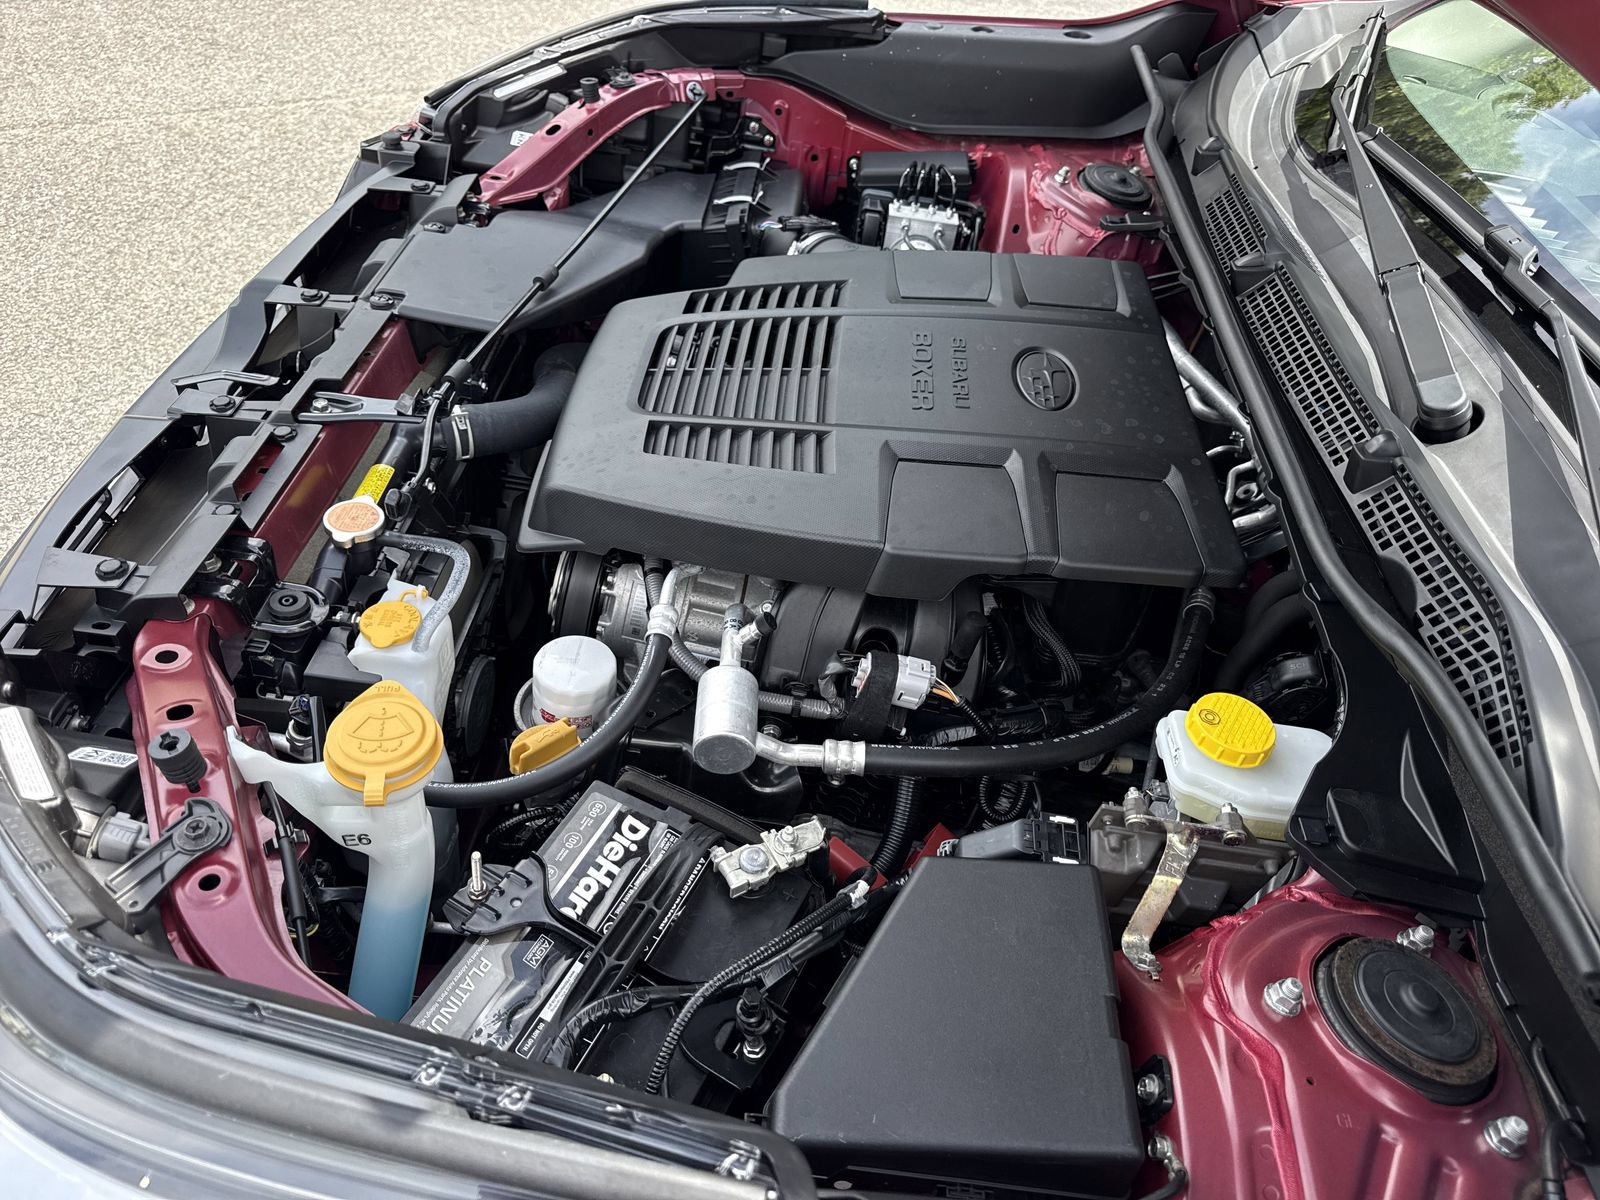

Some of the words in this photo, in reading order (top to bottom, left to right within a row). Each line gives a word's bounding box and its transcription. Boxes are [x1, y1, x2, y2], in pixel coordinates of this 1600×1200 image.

[911, 332, 934, 411] BOXER
[951, 336, 970, 409] SUBARU
[589, 803, 603, 817] 650
[341, 833, 373, 848] E6
[565, 835, 579, 849] 100
[530, 939, 550, 966] AGM
